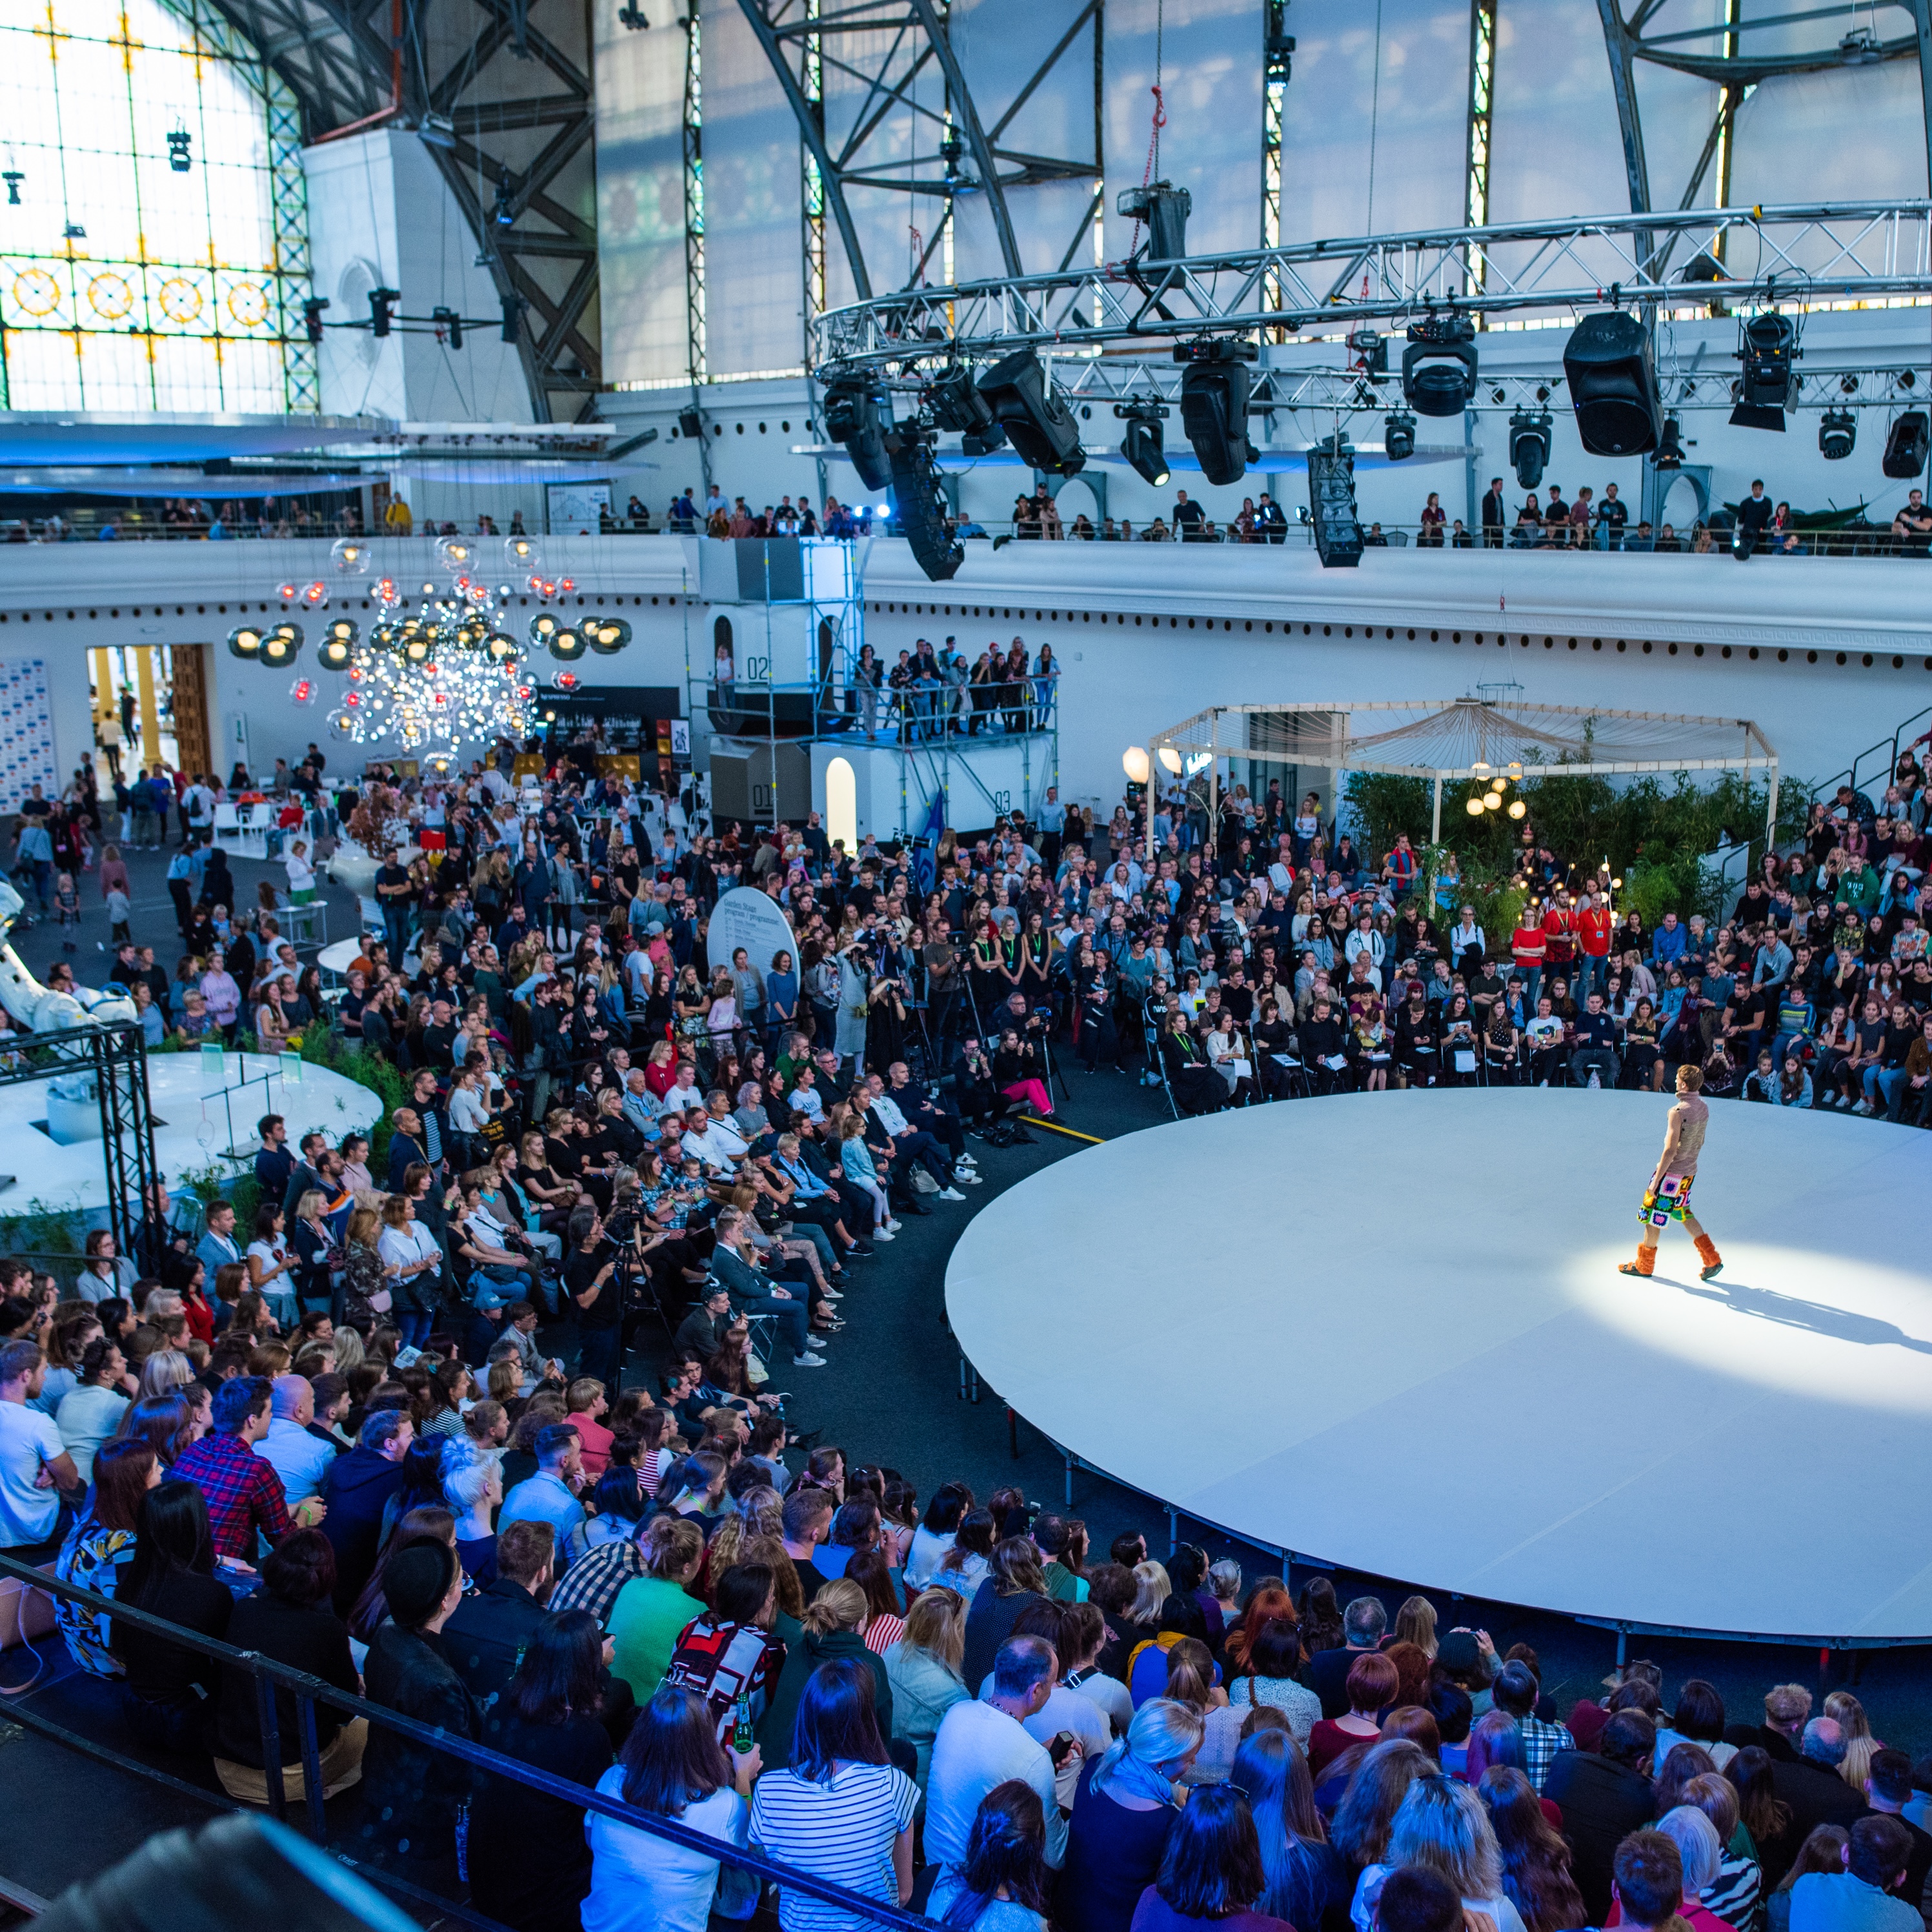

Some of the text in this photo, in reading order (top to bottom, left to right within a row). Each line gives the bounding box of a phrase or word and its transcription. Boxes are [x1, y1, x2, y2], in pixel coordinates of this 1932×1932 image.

[748, 657, 768, 679] 02
[753, 784, 772, 807] 01
[995, 790, 1011, 814] 03
[724, 898, 757, 913] Garden Stage
[724, 907, 745, 918] program
